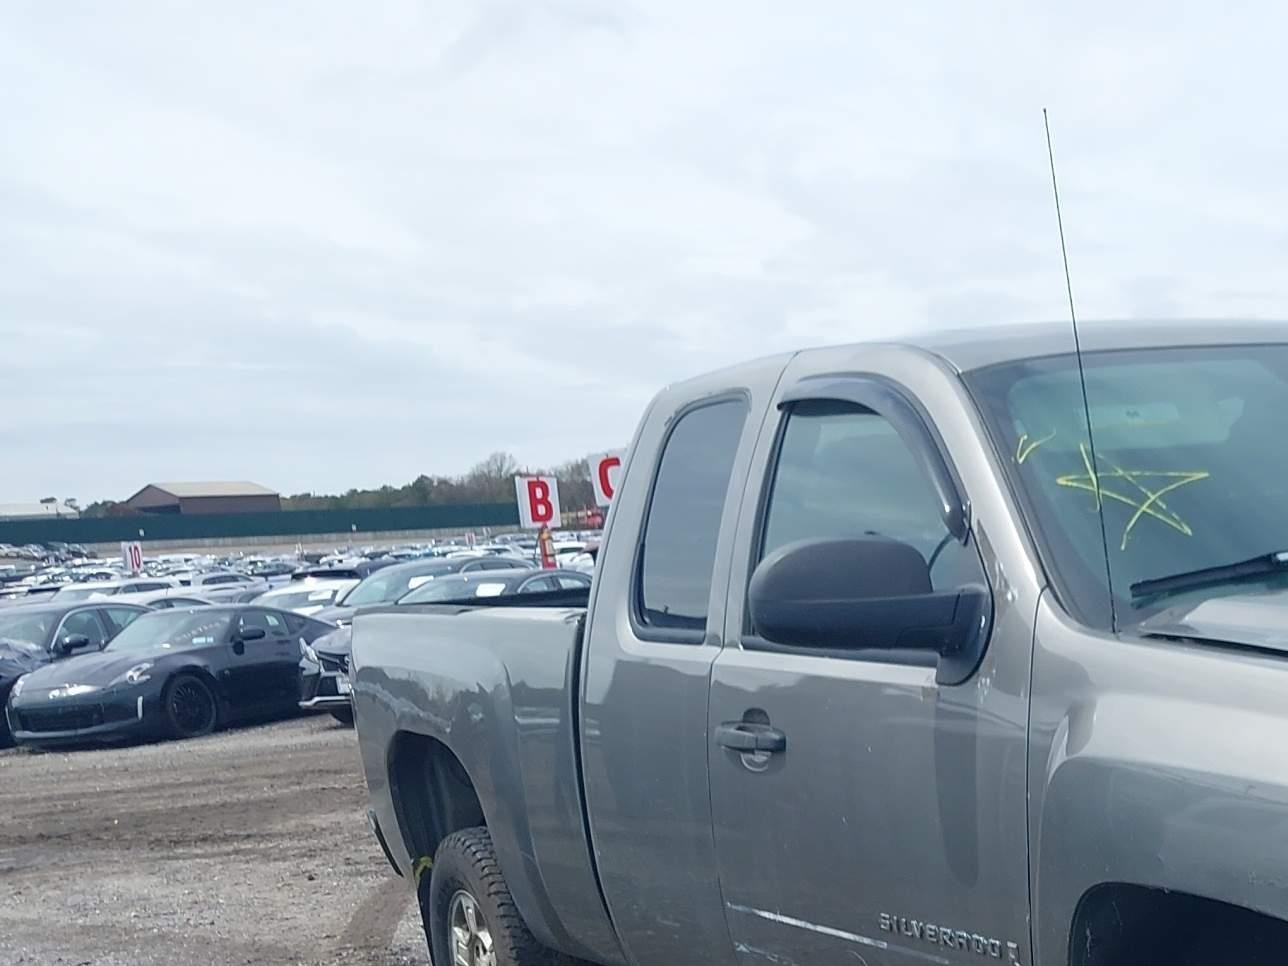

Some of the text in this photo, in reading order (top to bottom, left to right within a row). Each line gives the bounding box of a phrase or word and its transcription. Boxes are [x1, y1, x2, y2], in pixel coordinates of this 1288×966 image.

[527, 480, 554, 523] B
[128, 545, 141, 569] 10
[879, 912, 1002, 958] SILVERADO
